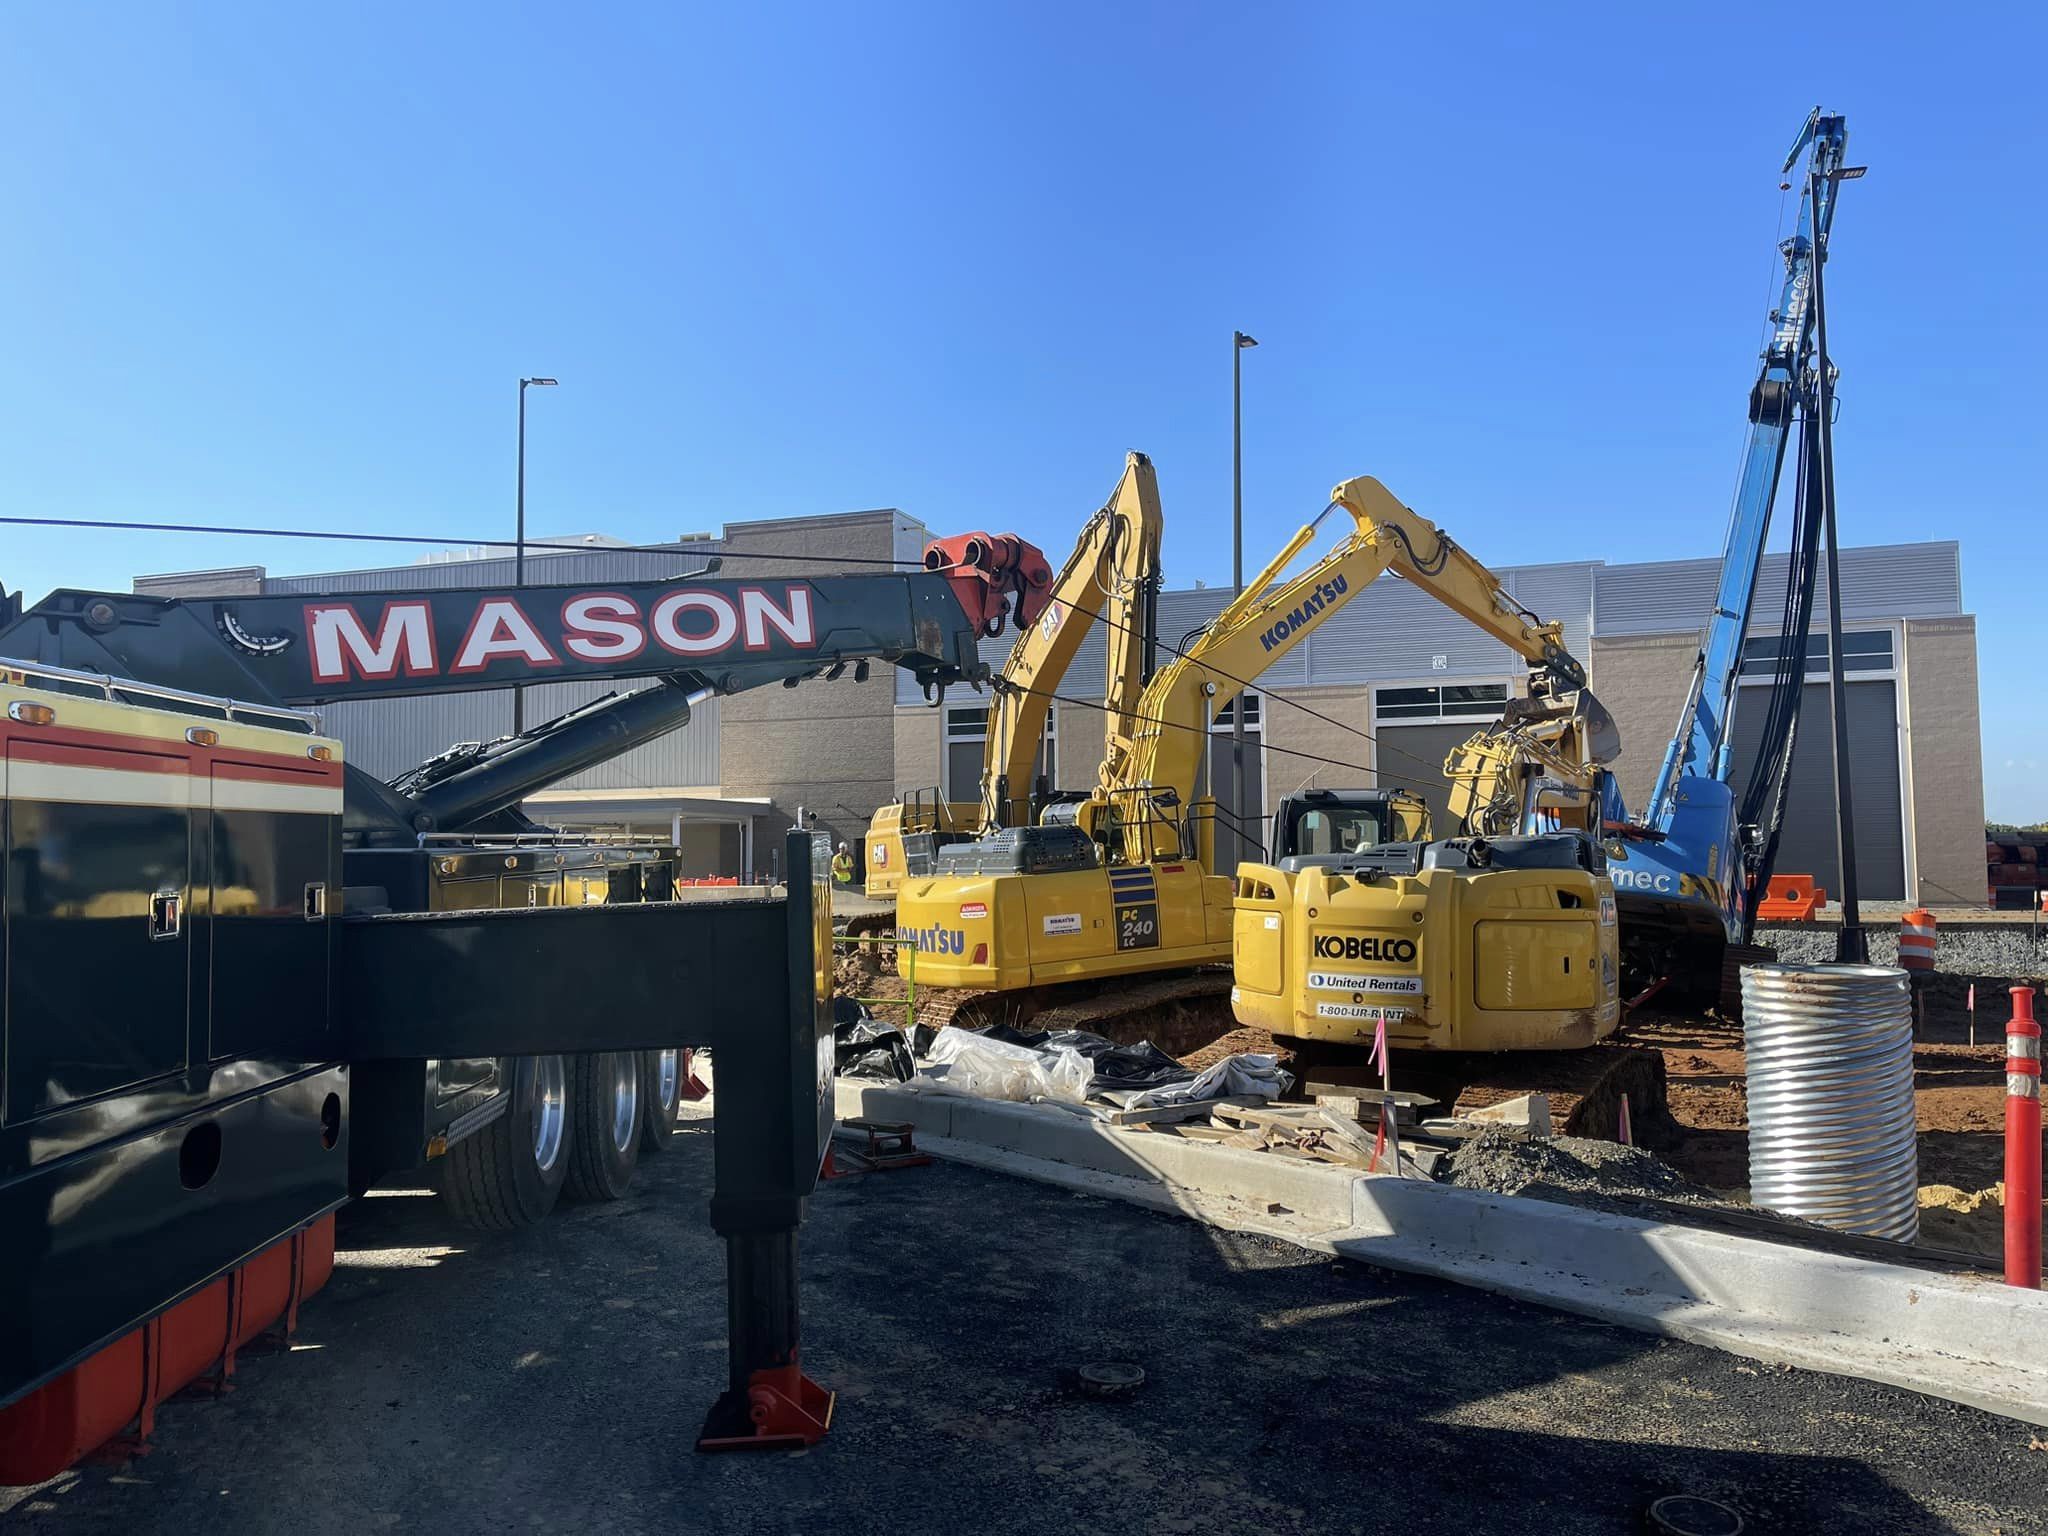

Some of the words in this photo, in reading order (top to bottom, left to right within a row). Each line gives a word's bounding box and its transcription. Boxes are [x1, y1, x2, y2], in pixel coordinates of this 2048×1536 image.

[1041, 604, 1060, 641] CAT
[1259, 574, 1347, 652] KOMATSU
[305, 584, 816, 683] MASON
[1607, 865, 1671, 892] mec
[1122, 910, 1138, 921] PC
[1122, 920, 1154, 937] 240
[1123, 937, 1136, 947] LC
[1314, 935, 1417, 963] KOBELCO
[1327, 976, 1367, 989] United
[1369, 978, 1417, 991] Rentals
[1320, 1005, 1404, 1020] 1-800-UR-RNT
